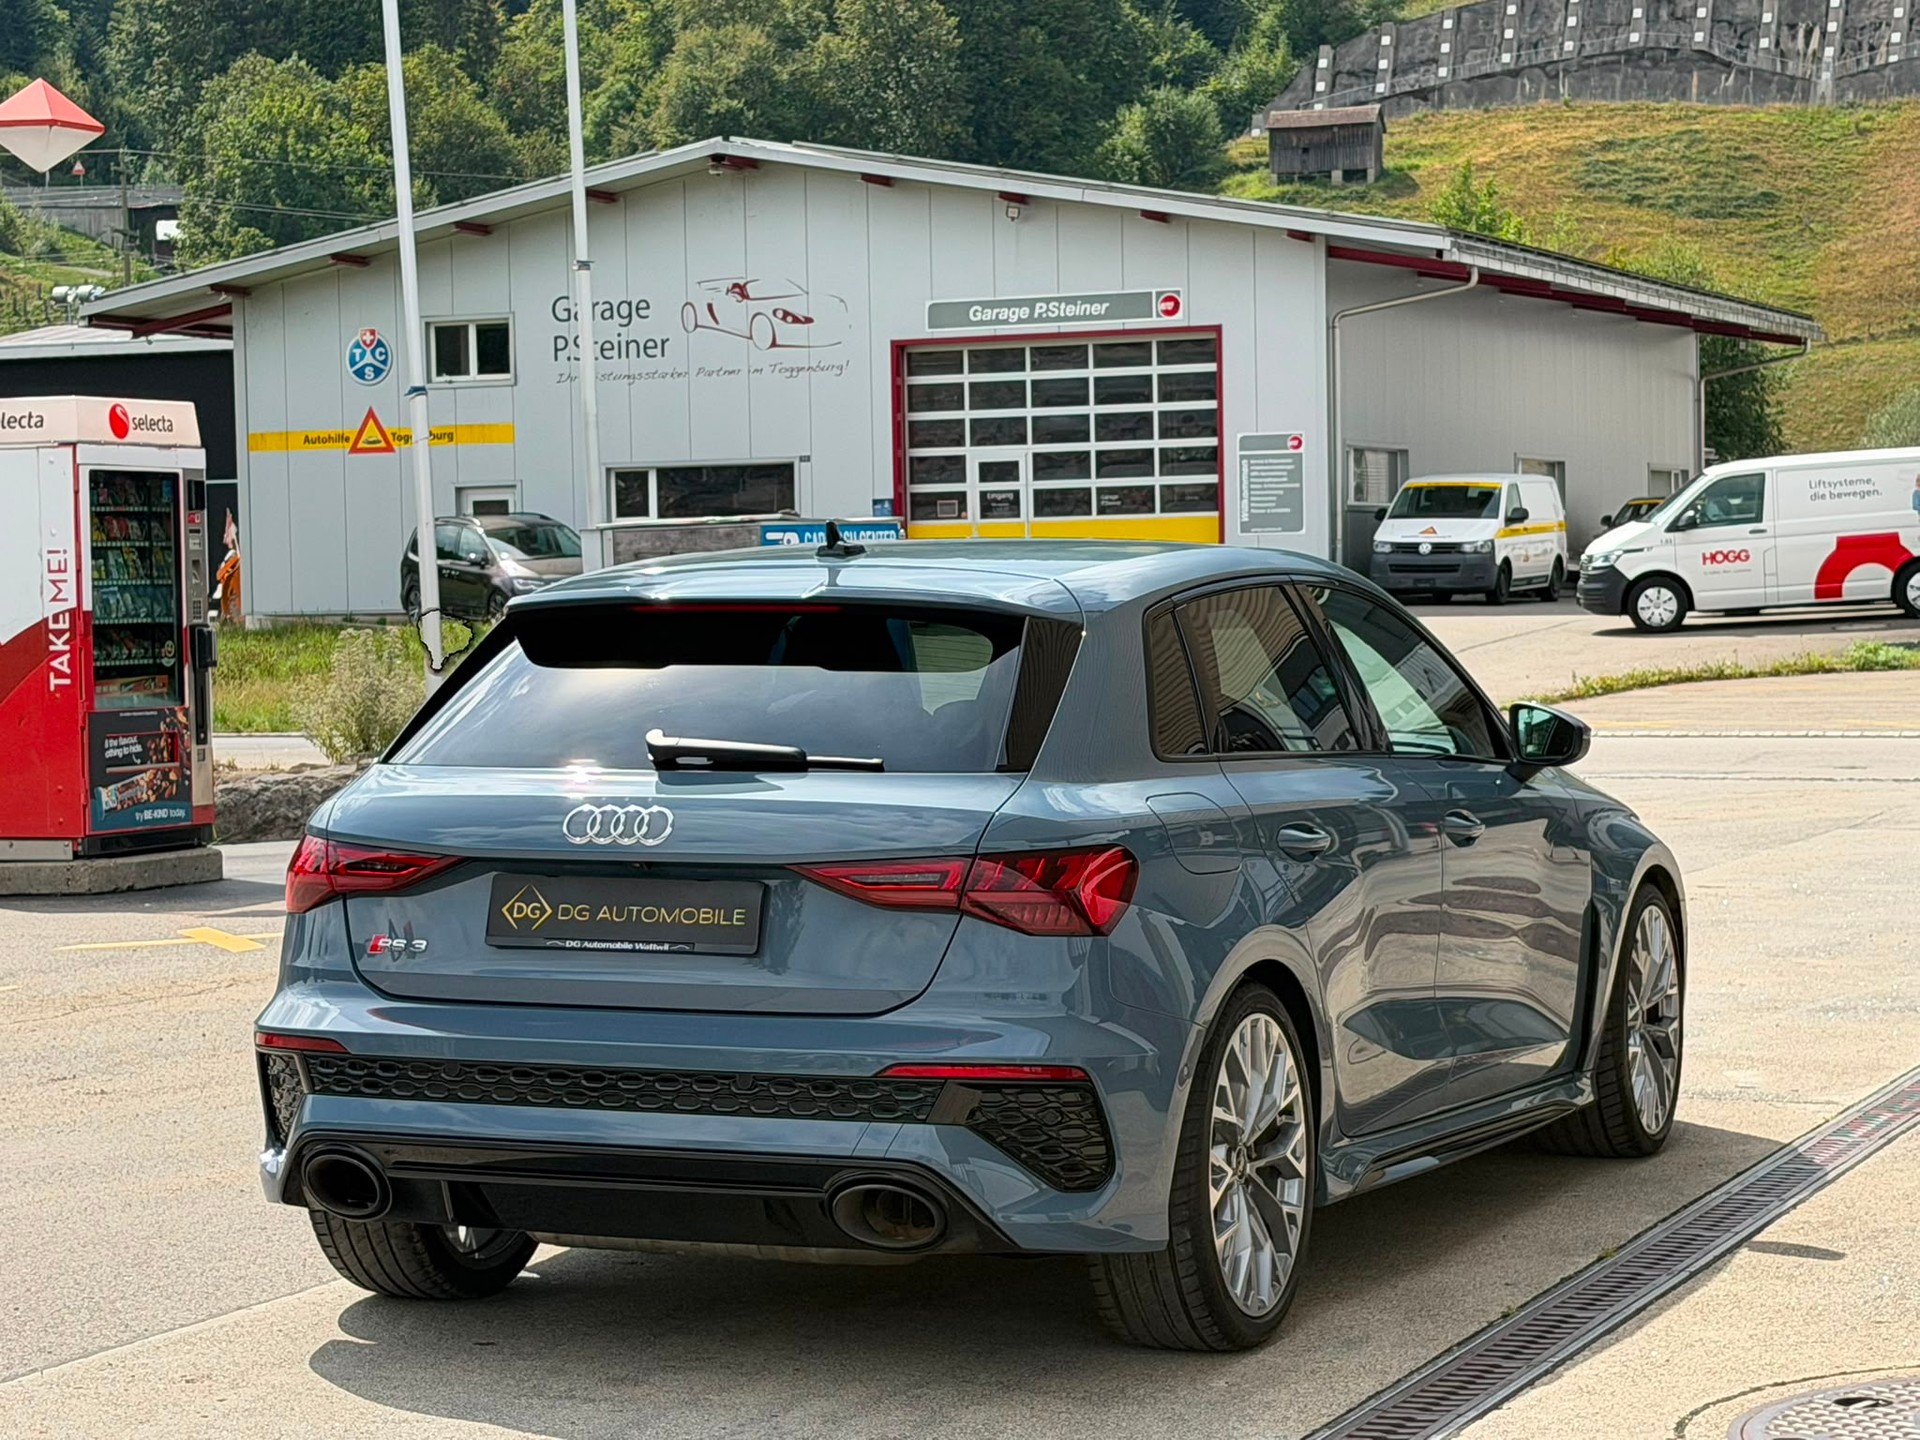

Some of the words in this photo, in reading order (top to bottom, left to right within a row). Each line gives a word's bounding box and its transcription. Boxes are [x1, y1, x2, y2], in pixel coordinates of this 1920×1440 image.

[969, 303, 1030, 323] Garage
[1034, 299, 1109, 319] P.Steiner
[696, 367, 741, 378] Partner
[748, 365, 763, 375] im
[769, 360, 850, 379] Toggenburg!
[0, 411, 44, 429] lecta
[132, 413, 173, 432] selecta
[303, 433, 350, 446] Autohilfe
[1808, 477, 1876, 490] Liftsysteme,
[1810, 491, 1827, 501] die
[1829, 487, 1883, 501] bewegen.
[47, 548, 68, 603] ME!
[48, 610, 71, 691] TAKE
[135, 812, 143, 822] try
[144, 808, 169, 820] BE-KIND
[513, 902, 541, 919] DG
[557, 904, 590, 921] DG
[596, 905, 746, 926] AUTOMOBILE
[566, 940, 581, 948] DG
[582, 941, 633, 950] Automobile
[635, 943, 669, 951] Wattwil
